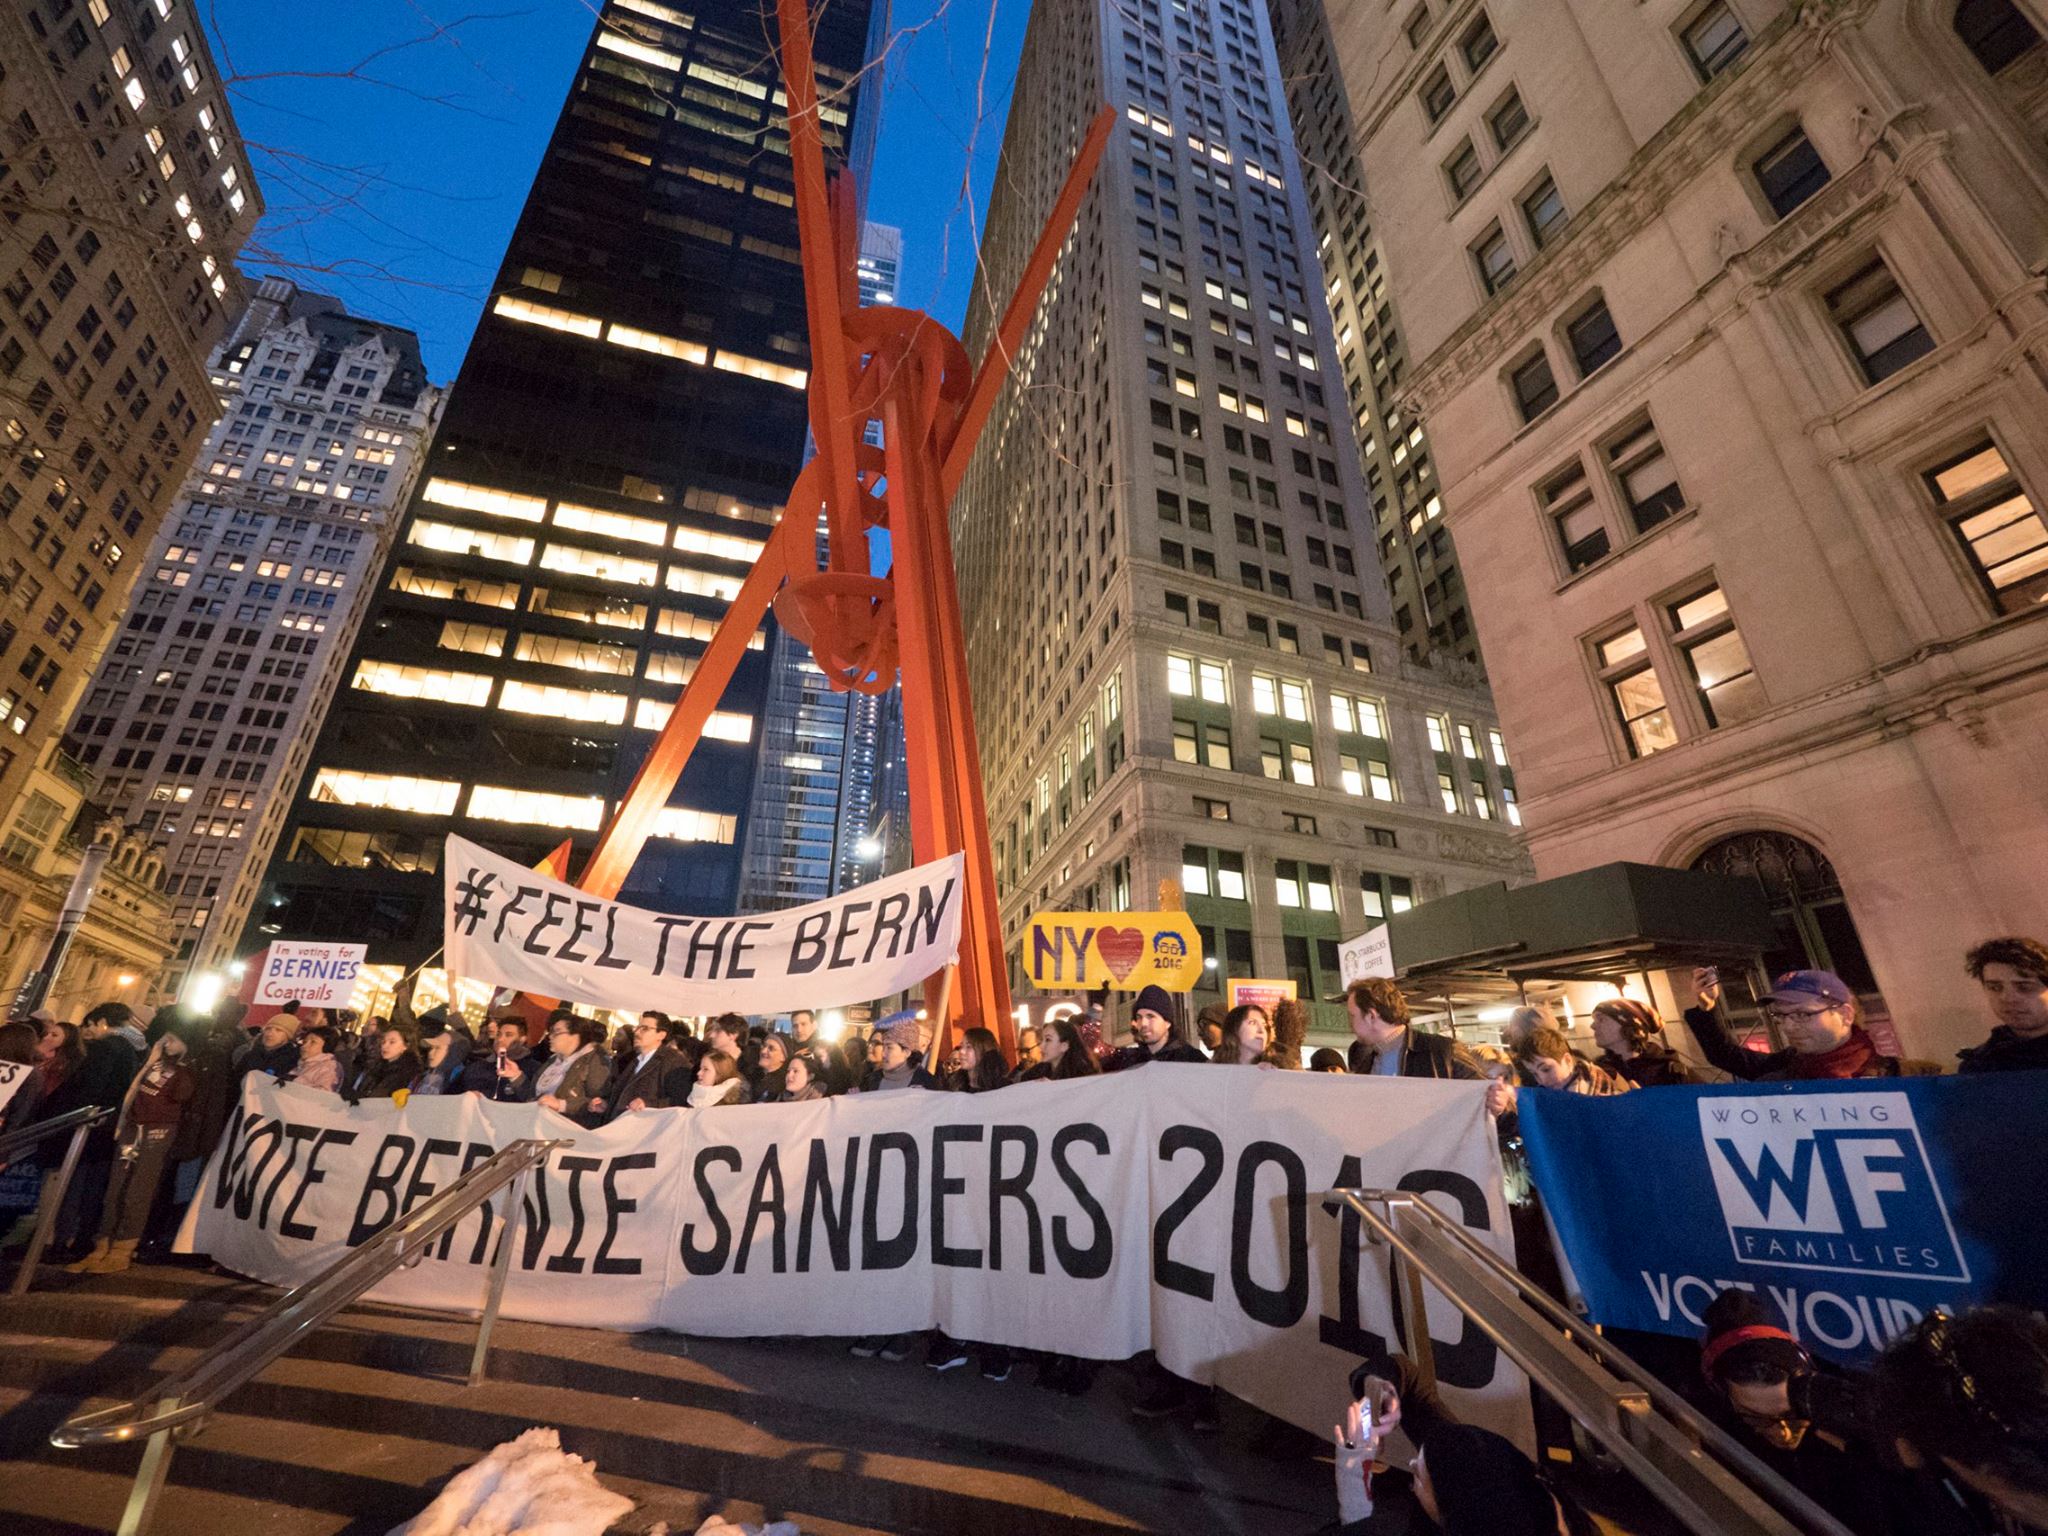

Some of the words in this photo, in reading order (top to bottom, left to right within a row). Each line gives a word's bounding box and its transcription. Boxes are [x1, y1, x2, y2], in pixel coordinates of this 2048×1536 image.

[452, 868, 631, 970] #FEEL
[651, 916, 774, 981] THE
[787, 878, 955, 975] BERN
[298, 947, 330, 959] voting
[338, 946, 355, 958] for
[1033, 924, 1096, 982] NY
[1358, 939, 1386, 957] STARBUCKS
[269, 958, 360, 980] BERNIES
[1153, 957, 1183, 970] 2016
[1364, 956, 1383, 970] COFFEE
[264, 981, 333, 1001] Coattails
[1711, 1105, 1889, 1125] WORKING
[214, 1106, 358, 1241] VOTE
[346, 1135, 656, 1275] BERNIE
[681, 1123, 1113, 1279] SANDERS
[1154, 1124, 1497, 1389] 2016
[1744, 1236, 1939, 1268] FAMILIES
[1641, 1271, 1756, 1326] VO
